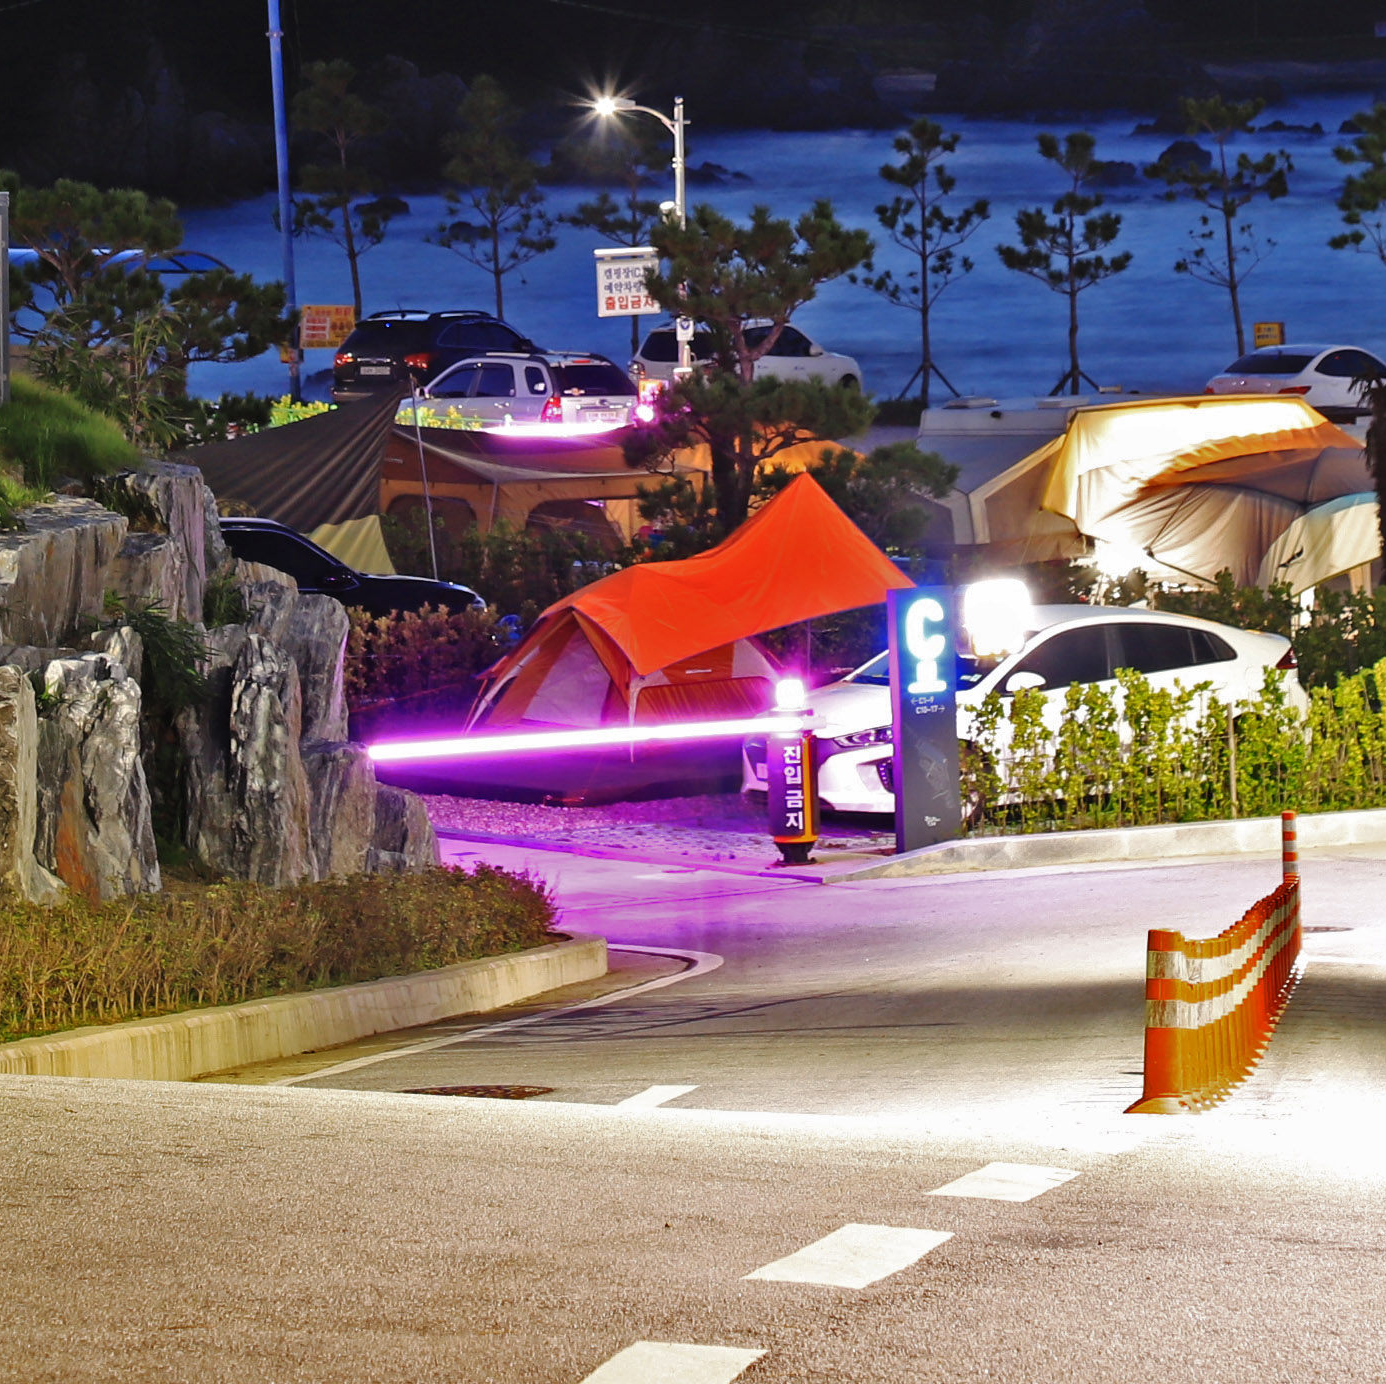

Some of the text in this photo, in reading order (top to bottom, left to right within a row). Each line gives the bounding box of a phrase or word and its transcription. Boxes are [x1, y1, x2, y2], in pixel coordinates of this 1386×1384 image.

[604, 266, 645, 279] 캠핑장(C
[605, 296, 654, 311] 출입금지
[905, 598, 946, 661] C
[783, 745, 804, 830] 진입금지
